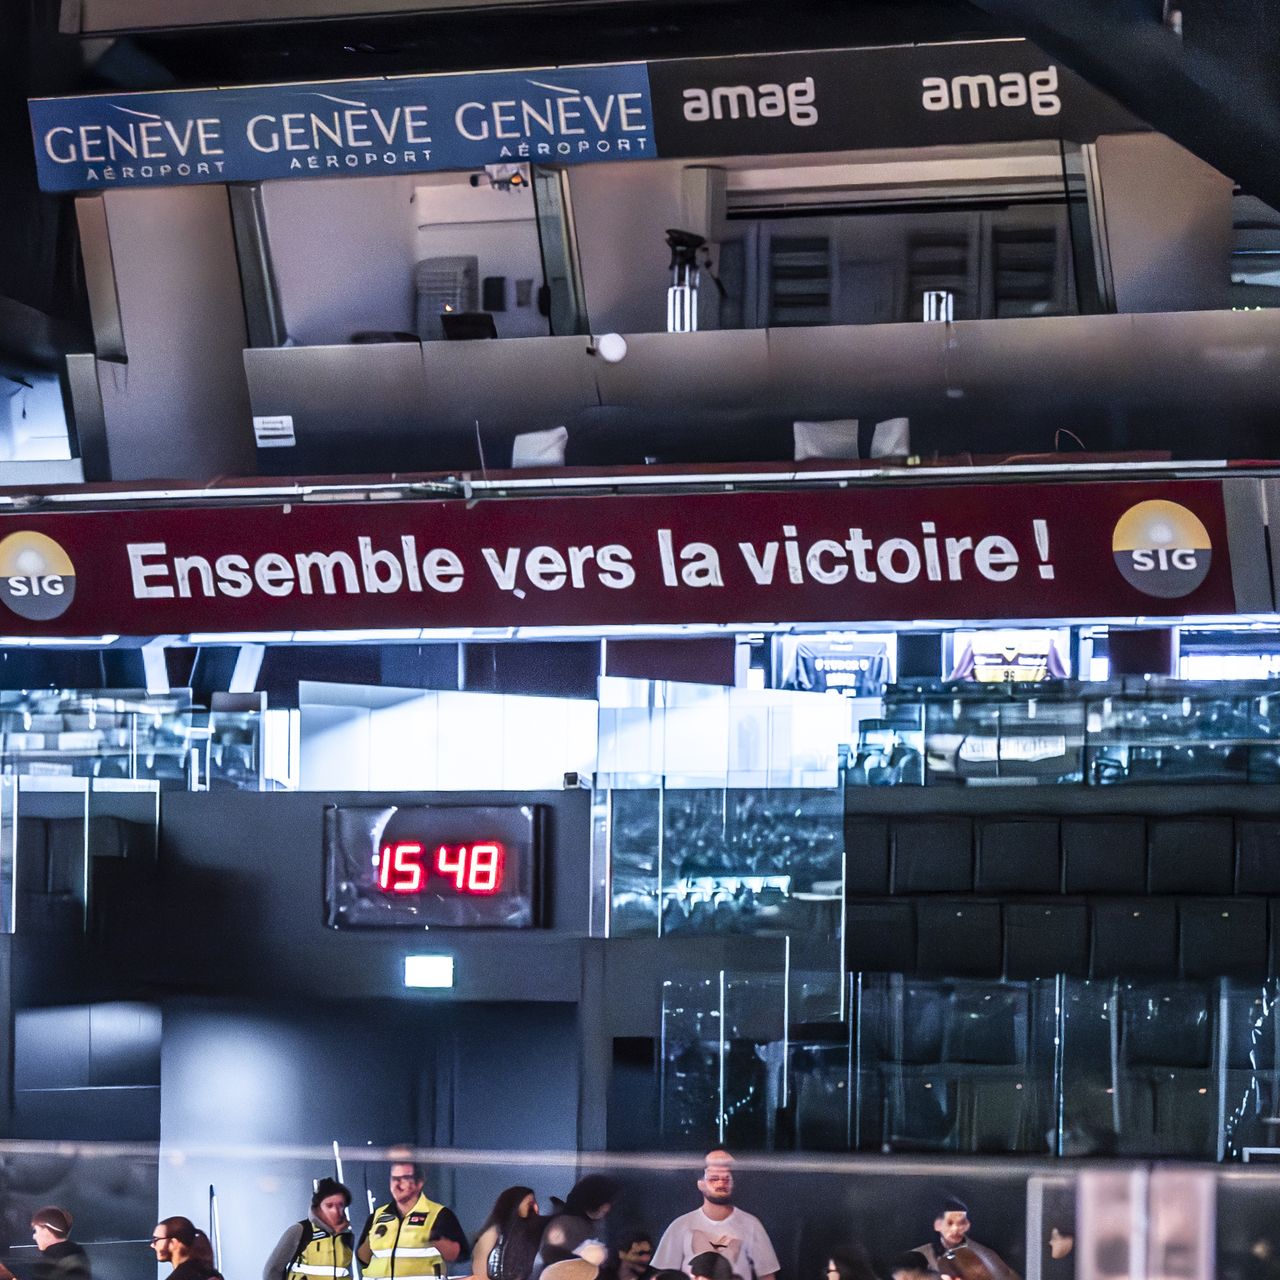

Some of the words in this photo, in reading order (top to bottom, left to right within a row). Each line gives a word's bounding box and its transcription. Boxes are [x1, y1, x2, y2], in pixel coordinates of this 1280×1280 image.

[45, 104, 224, 164] GENÈVE
[246, 92, 432, 153] GENÈVE
[455, 79, 647, 140] GENÈVE
[683, 77, 819, 126] amag
[922, 65, 1061, 116] amag
[9, 575, 65, 597] SIG
[126, 535, 465, 600] Ensemble
[481, 541, 636, 593] vers
[658, 529, 725, 588] la
[738, 520, 1020, 587] victoire
[1131, 547, 1198, 573] SIG
[380, 845, 422, 890] 15
[438, 845, 499, 890] 48
